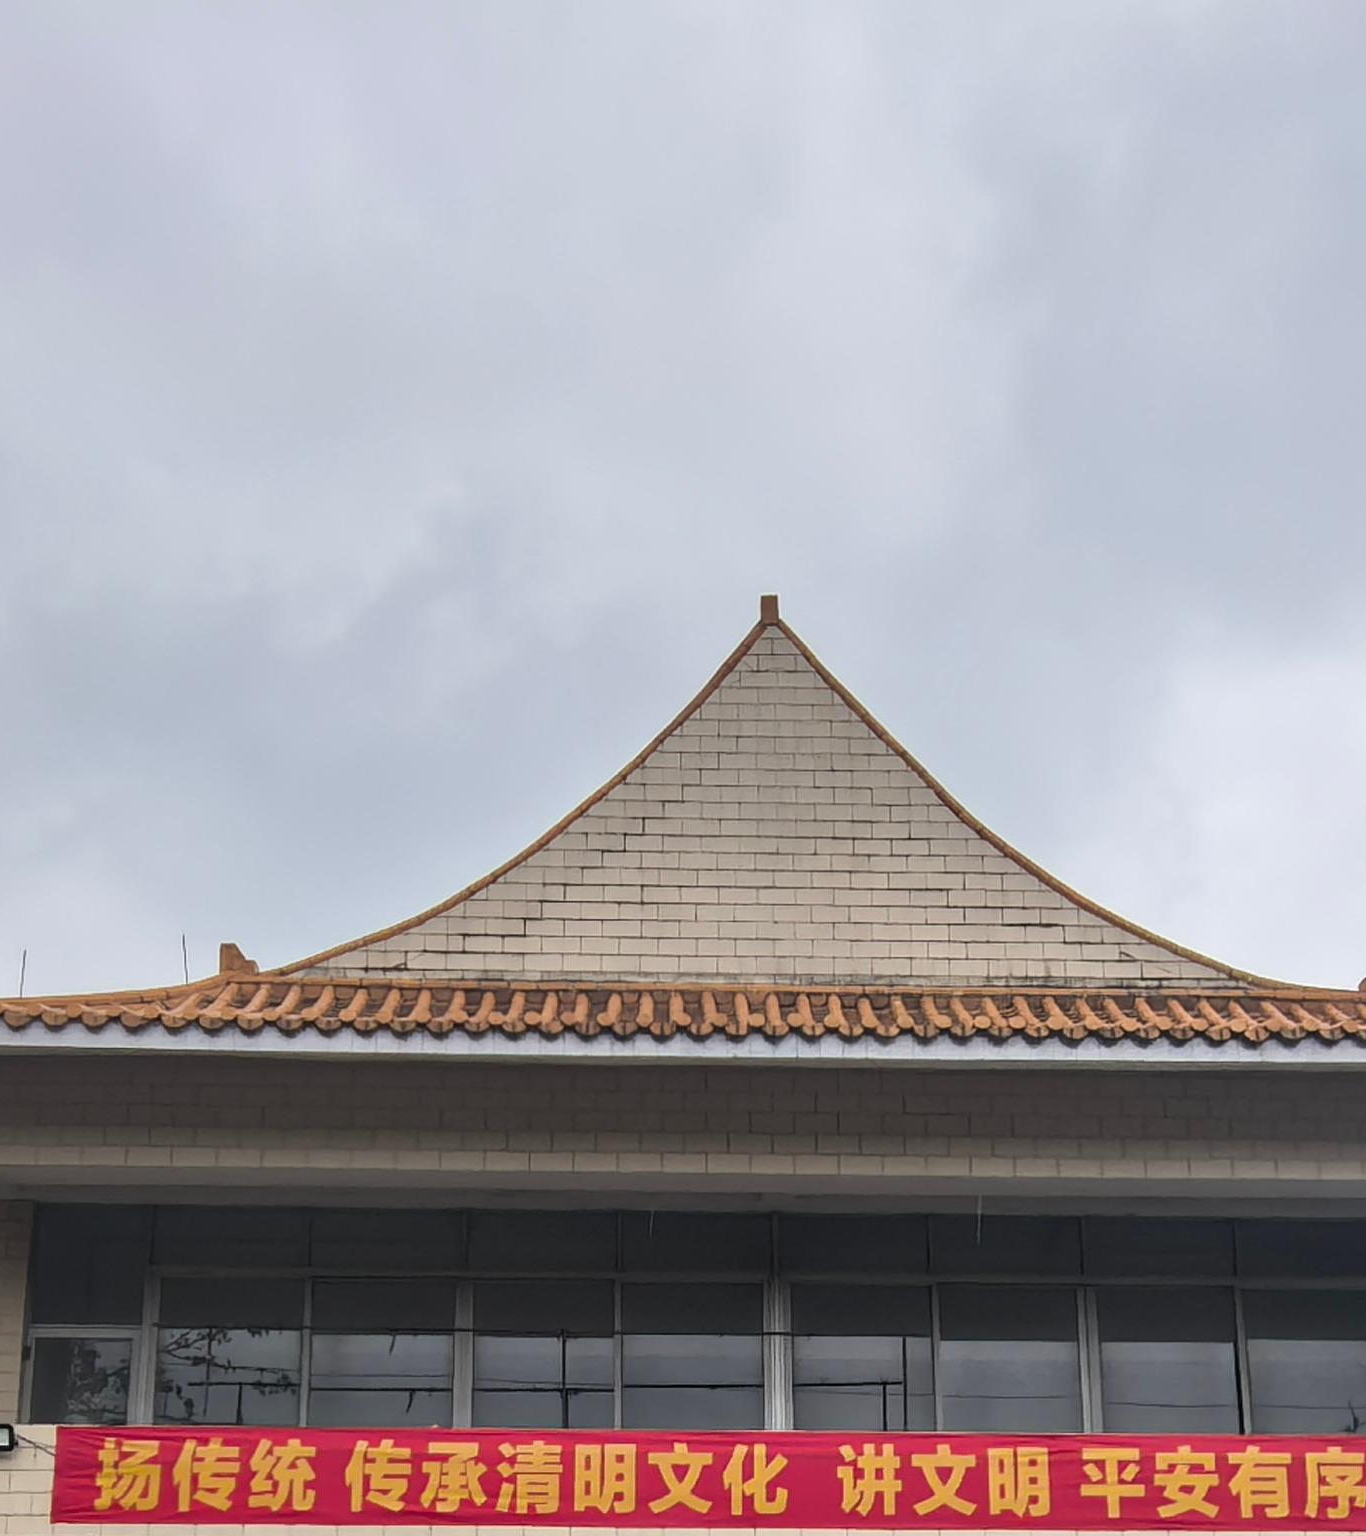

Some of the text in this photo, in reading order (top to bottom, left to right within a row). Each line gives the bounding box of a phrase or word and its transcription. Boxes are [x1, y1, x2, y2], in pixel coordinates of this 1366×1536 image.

[95, 1438, 317, 1513] 扬传统
[345, 1439, 789, 1517] 传承清明文化
[837, 1443, 1051, 1518] 讲文明
